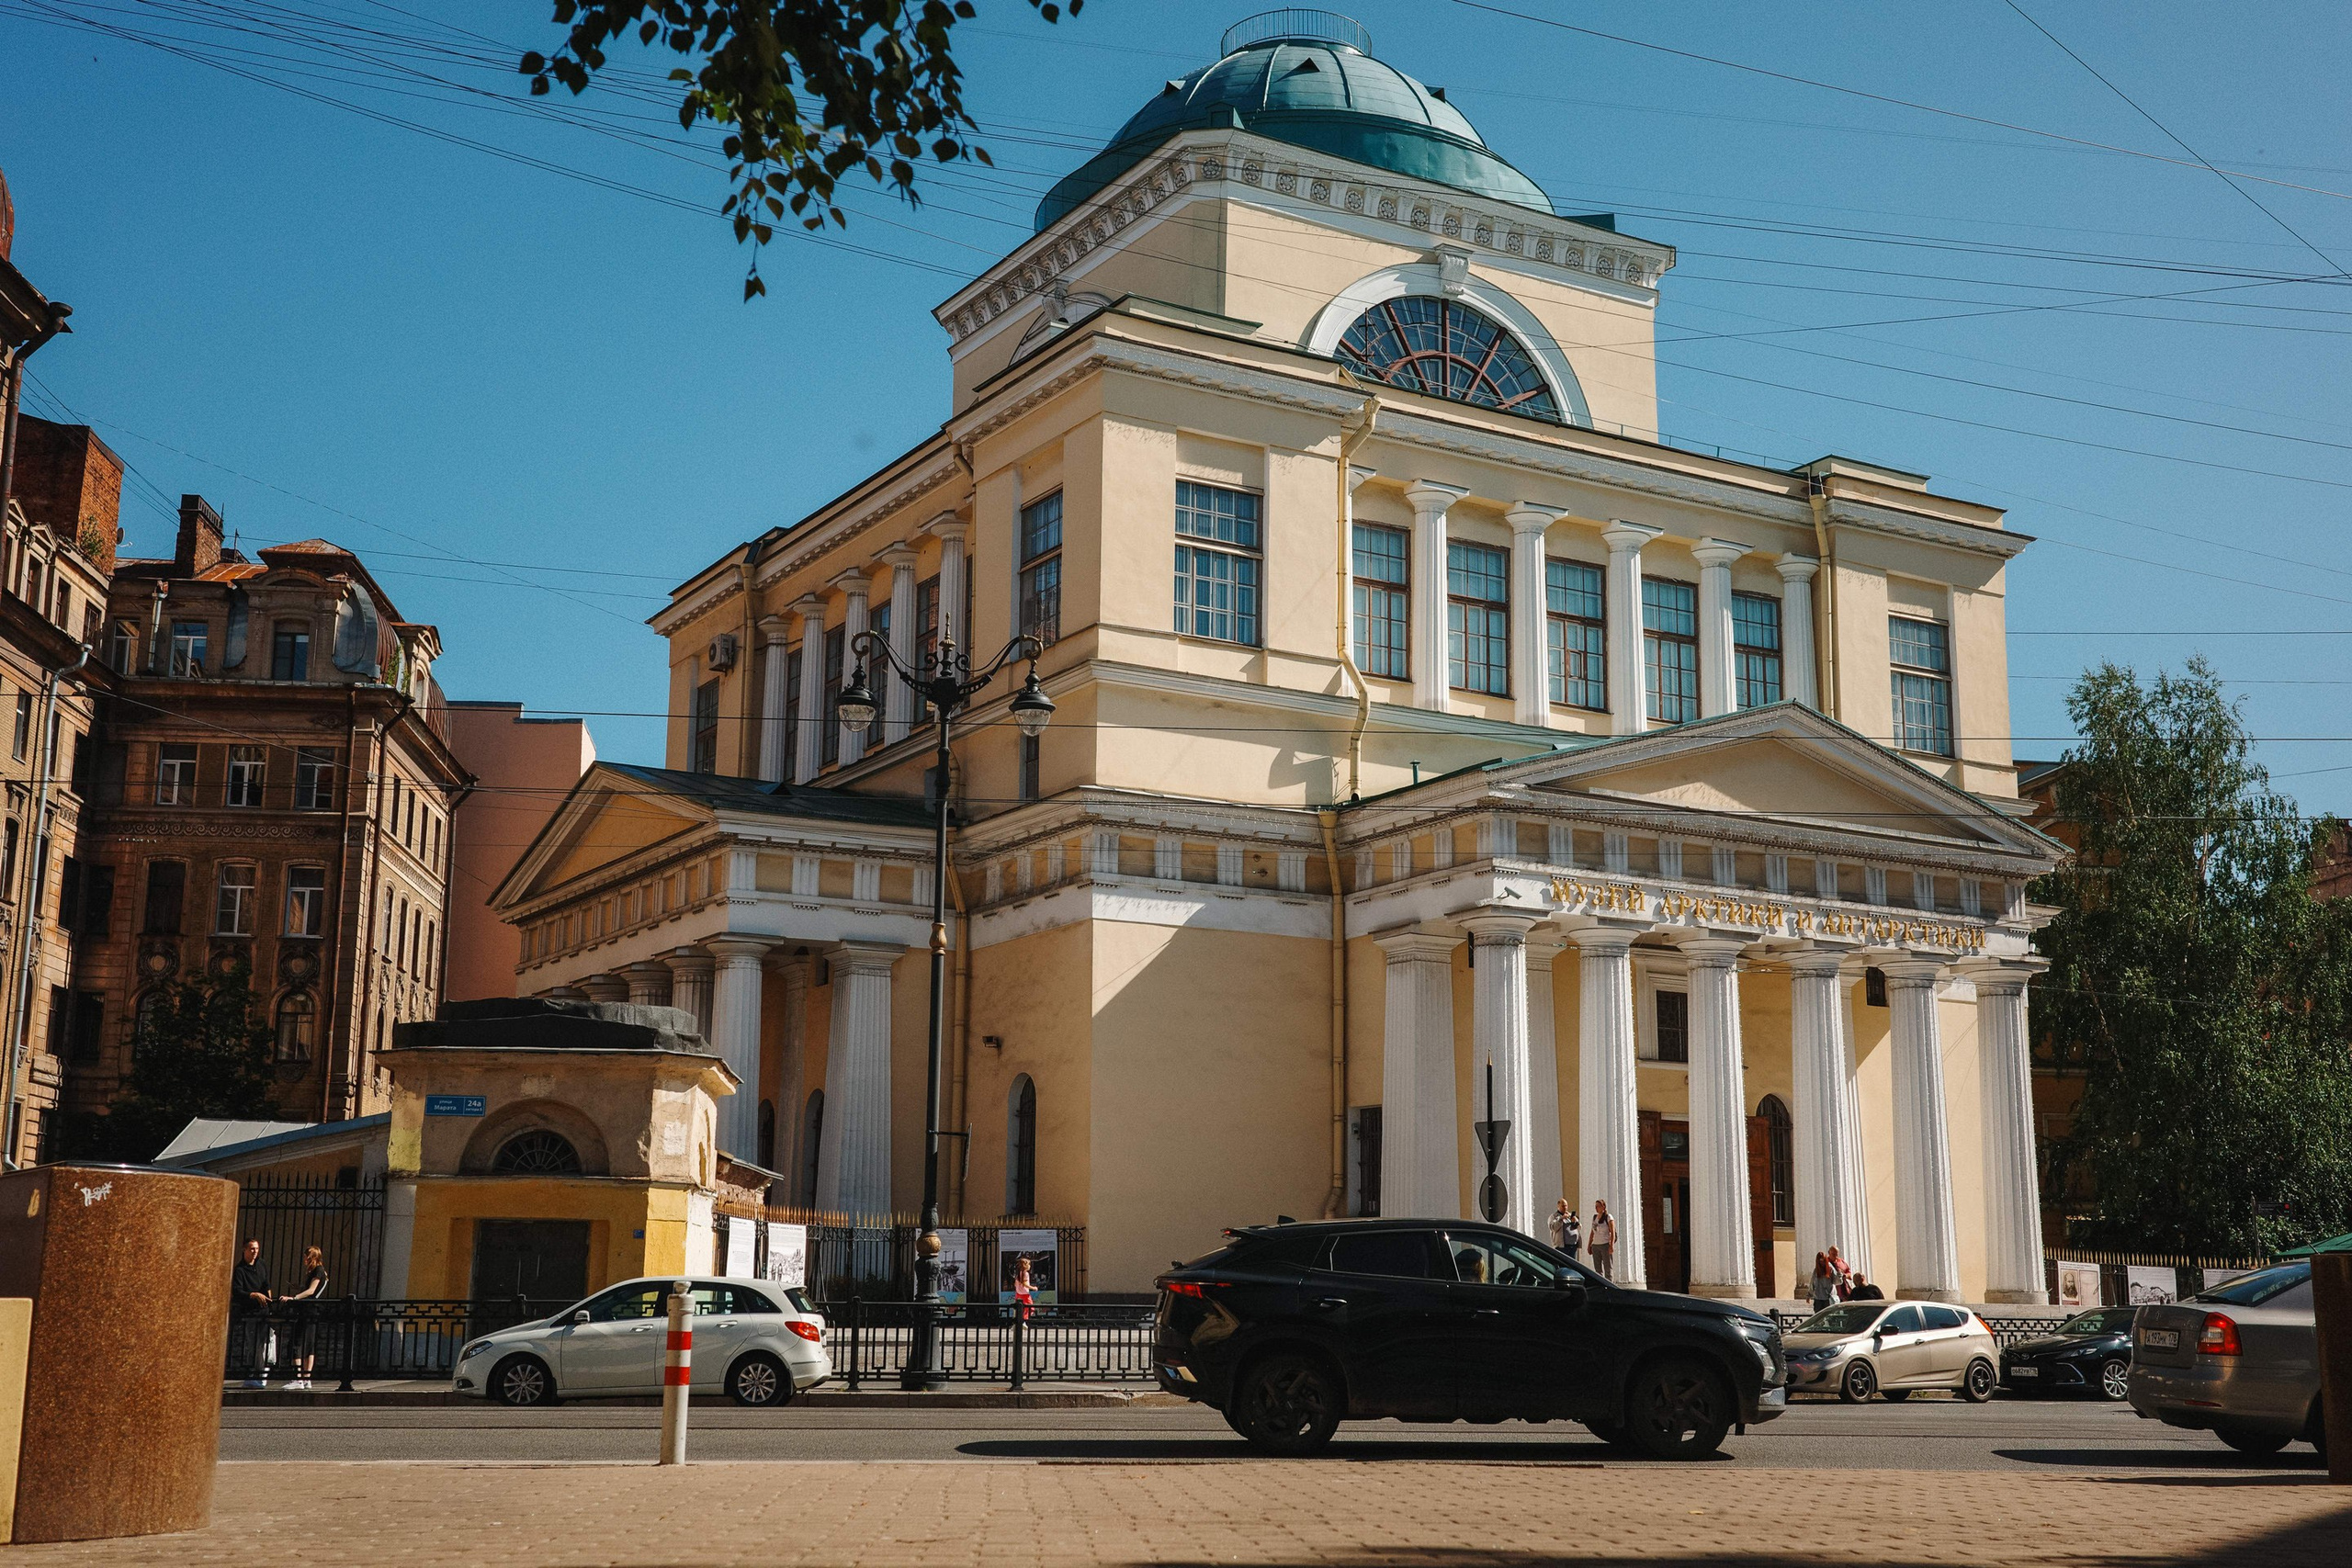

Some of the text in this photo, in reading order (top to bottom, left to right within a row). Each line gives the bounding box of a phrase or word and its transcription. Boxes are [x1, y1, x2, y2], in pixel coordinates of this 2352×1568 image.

[1552, 879, 1987, 948] МУЗЕЙ АРКТИКИ И АНТАРКТИКИ
